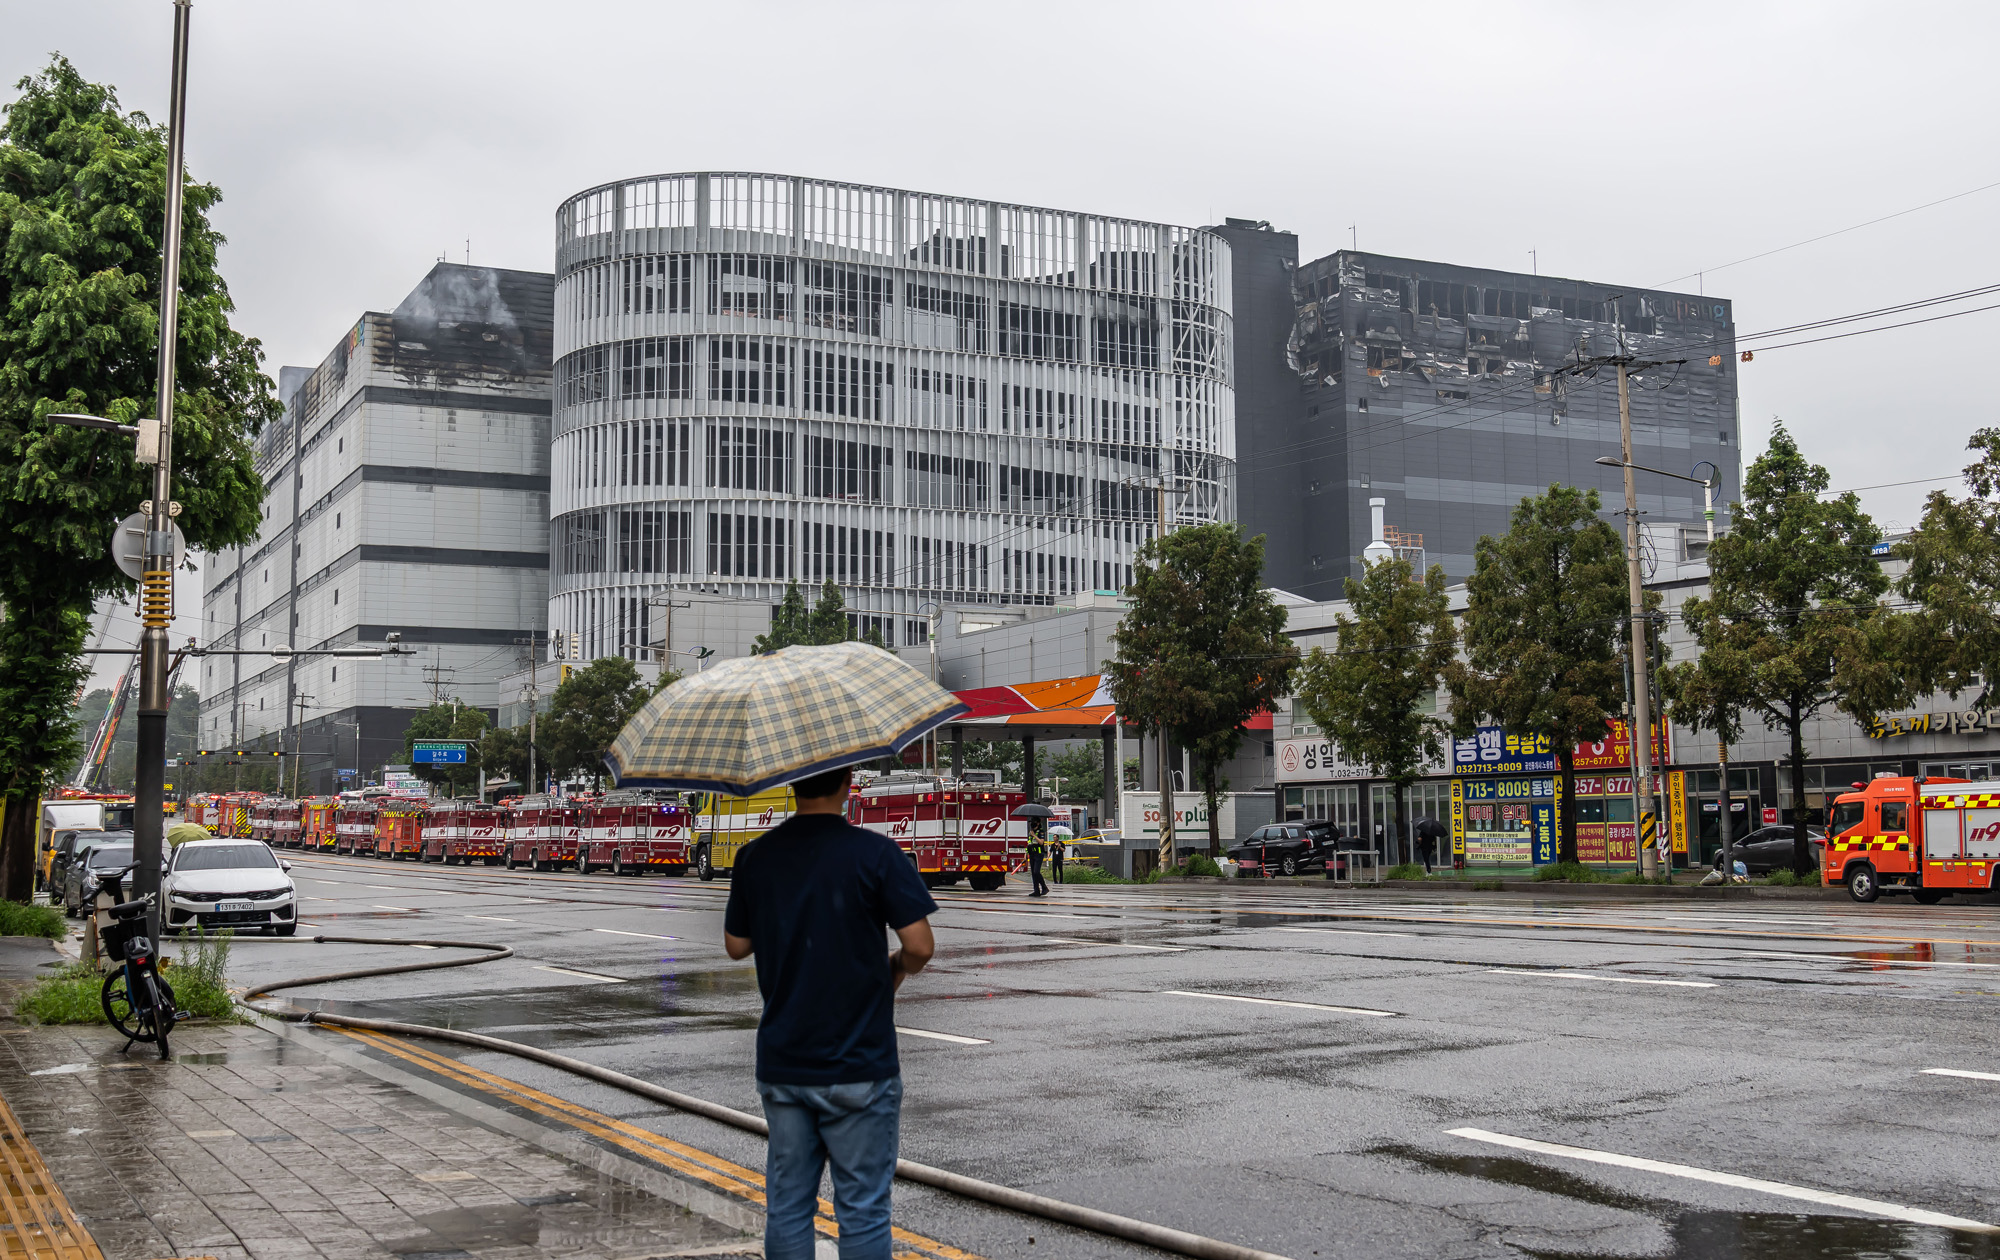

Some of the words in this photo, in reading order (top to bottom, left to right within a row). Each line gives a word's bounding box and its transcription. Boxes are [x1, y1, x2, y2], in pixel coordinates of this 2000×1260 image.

[1455, 730, 1502, 762] 동행
[1505, 732, 1551, 756] 부동산
[1456, 762, 1522, 774] 032)713-8009
[1532, 780, 1554, 796] 동행
[758, 806, 774, 827] 119
[1144, 810, 1184, 823] sox
[1185, 806, 1208, 827] plu
[1469, 805, 1493, 820] 매매
[1502, 804, 1527, 820] 임대
[472, 825, 494, 836] 119
[567, 828, 579, 837] 11
[654, 825, 681, 839] 119
[891, 816, 909, 836] 119
[968, 817, 1002, 836] 119
[1538, 808, 1551, 861] 부동산
[1968, 821, 2000, 842] 119
